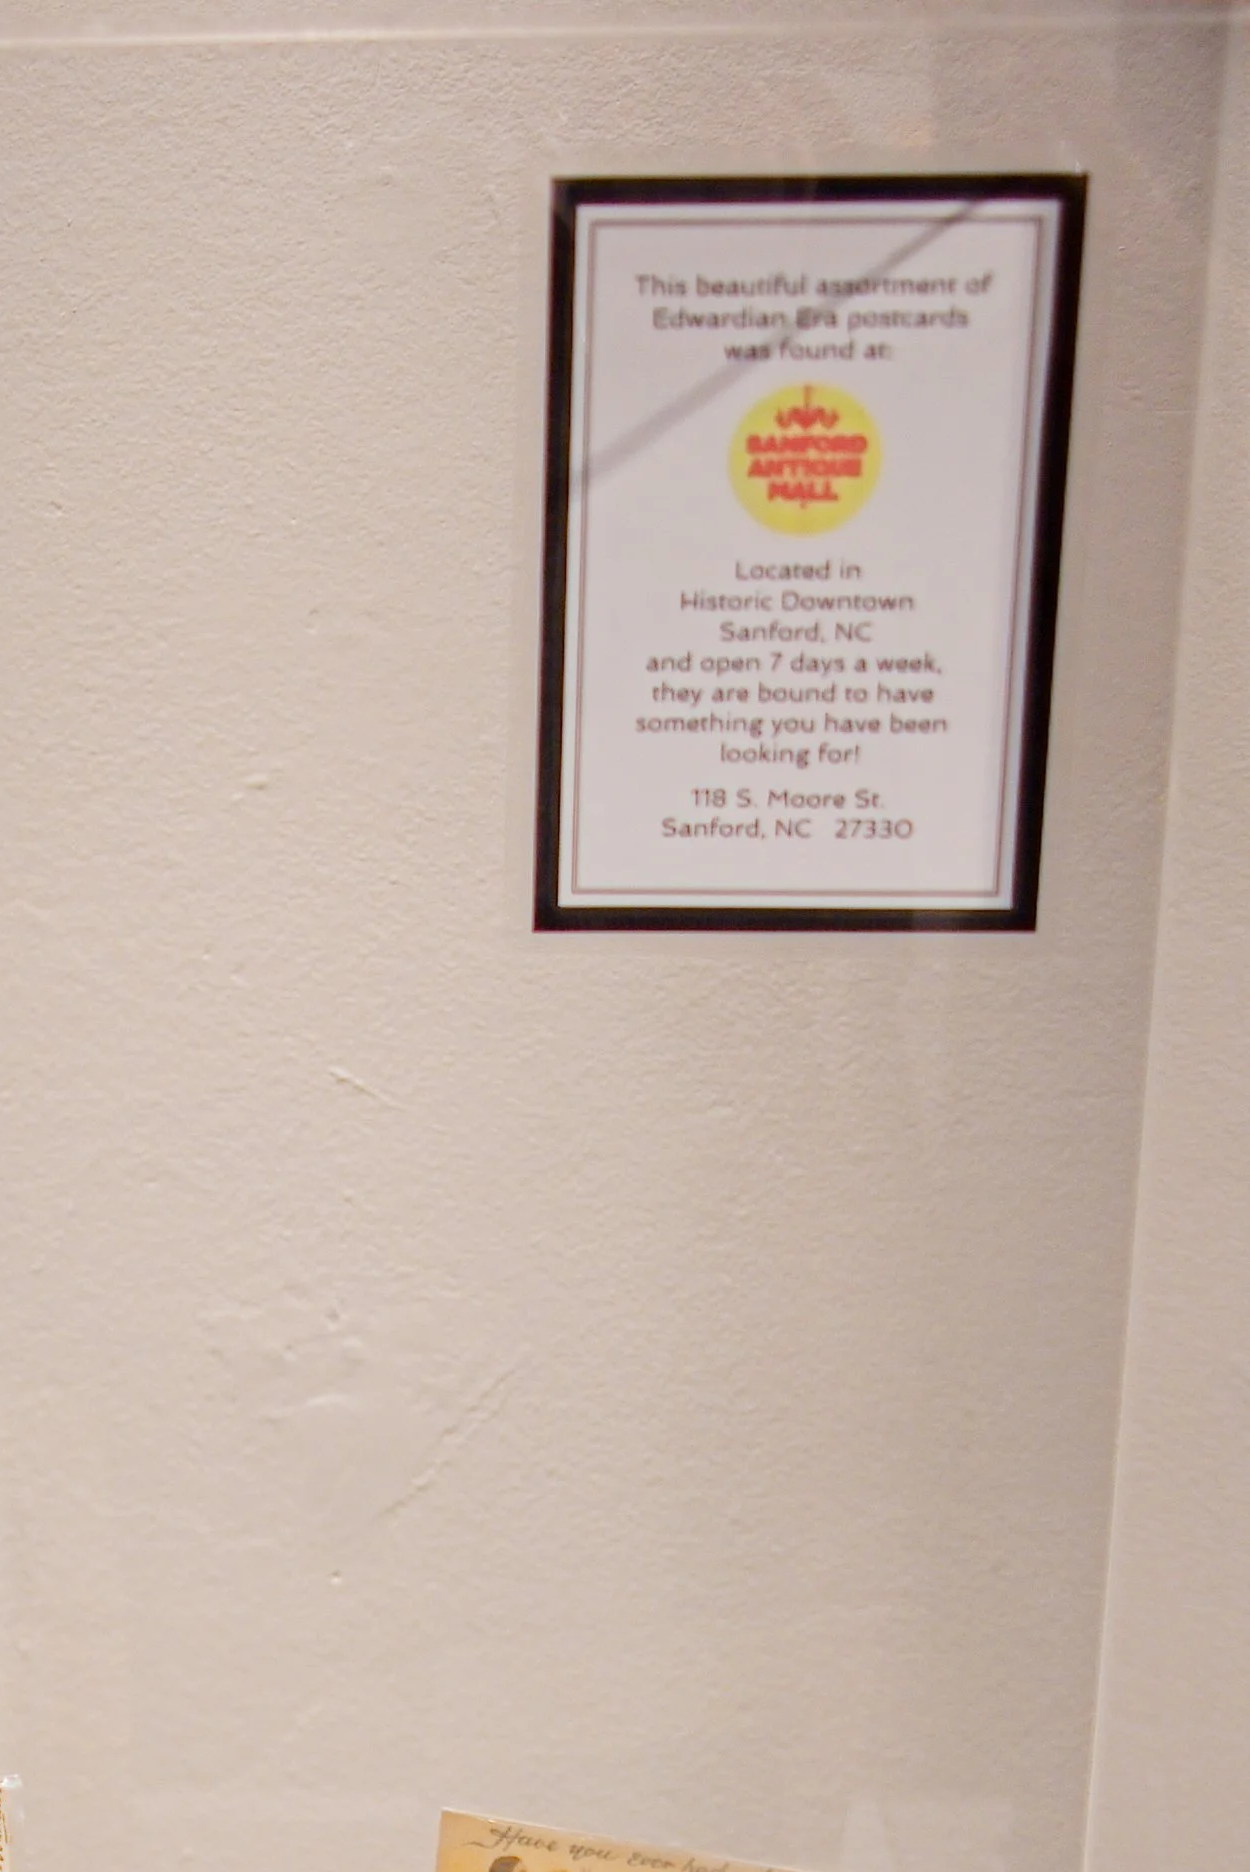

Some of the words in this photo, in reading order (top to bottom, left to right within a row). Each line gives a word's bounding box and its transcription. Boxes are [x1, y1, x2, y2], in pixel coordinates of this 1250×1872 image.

[636, 273, 687, 296] This
[696, 273, 807, 297] beautiful
[815, 275, 957, 297] assortment
[964, 271, 993, 295] of
[652, 306, 787, 330] Edwardian
[796, 306, 838, 330] Era
[847, 306, 970, 332] postcards
[724, 343, 770, 361] was
[780, 338, 855, 360] found
[746, 434, 868, 453] SANFORD
[747, 459, 862, 478] ANTIQUE
[767, 482, 839, 502] MALL
[735, 560, 831, 581] Located
[840, 560, 862, 580] in
[680, 590, 772, 612] Historic
[781, 590, 915, 612] Downtown
[719, 621, 825, 643] Sanford,
[835, 621, 872, 642] NC
[646, 652, 692, 673] and
[700, 655, 761, 677] open
[770, 652, 783, 673] 7
[790, 652, 845, 677] days
[854, 656, 867, 673] a
[876, 651, 944, 676] week,
[652, 682, 703, 708] they
[711, 687, 749, 704] are
[758, 682, 838, 704] bound
[845, 685, 869, 704] to
[877, 682, 935, 704] have
[635, 712, 765, 739] something
[771, 717, 816, 738] you
[824, 712, 881, 734] have
[889, 712, 949, 734] been
[720, 742, 811, 769] looking
[817, 742, 862, 764] for!
[690, 788, 728, 809] 118
[736, 788, 758, 809] S.
[767, 788, 848, 809] Moore
[854, 788, 886, 809] St.
[661, 816, 766, 841] Sanford,
[775, 819, 813, 840] NC
[834, 818, 915, 840] 27330
[463, 1826, 558, 1851] Have
[569, 1843, 619, 1861] you
